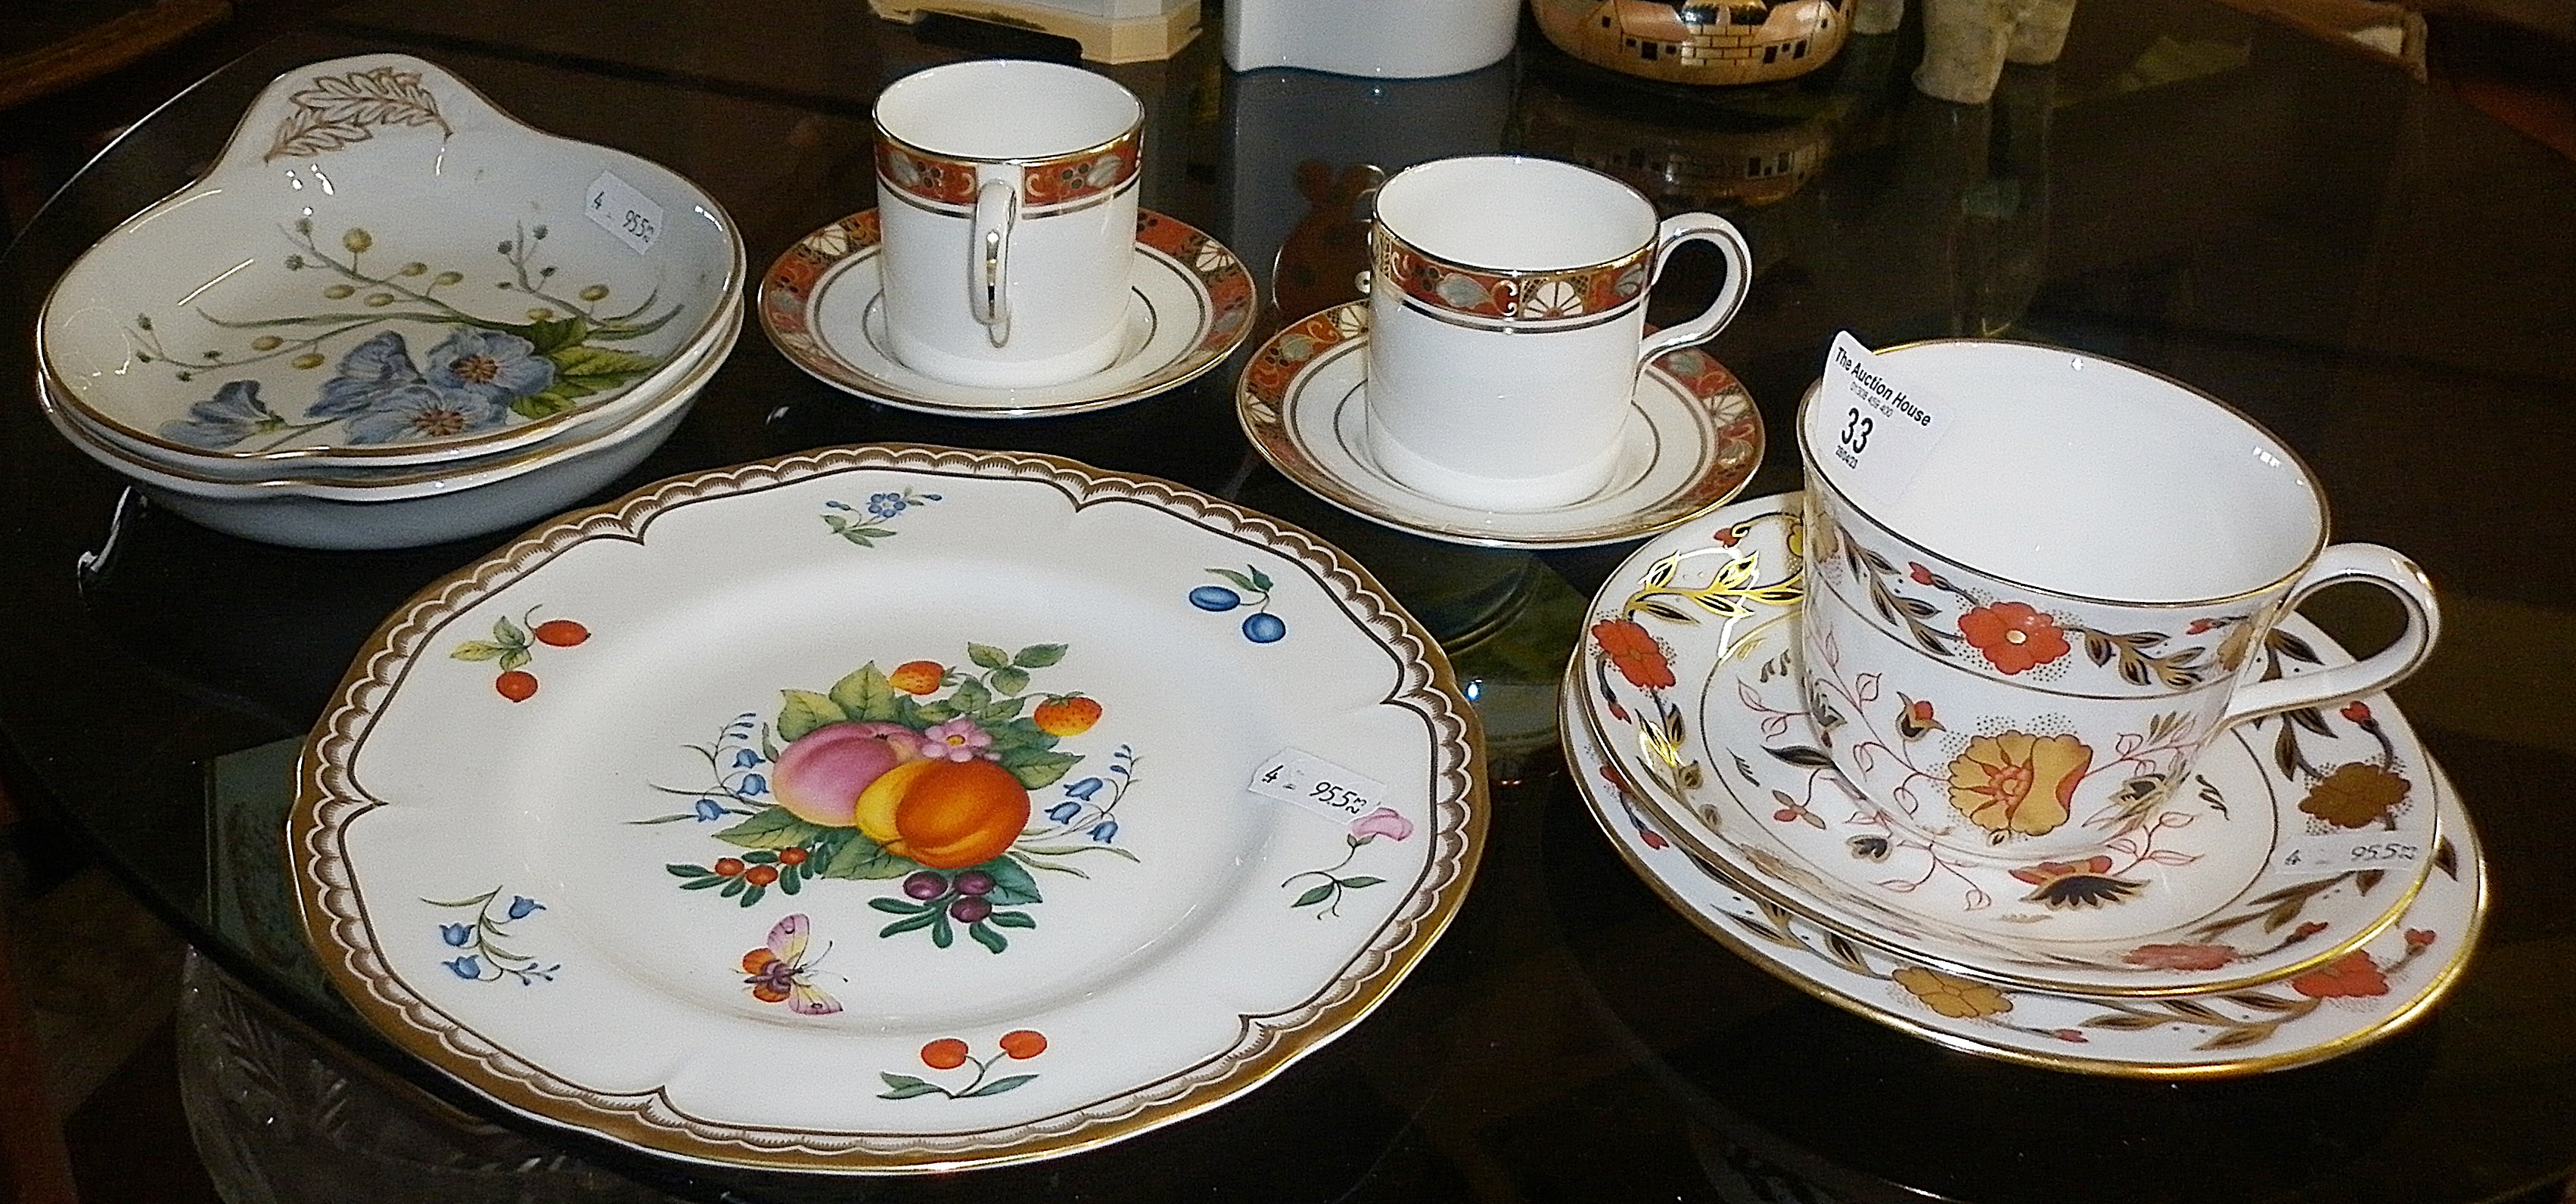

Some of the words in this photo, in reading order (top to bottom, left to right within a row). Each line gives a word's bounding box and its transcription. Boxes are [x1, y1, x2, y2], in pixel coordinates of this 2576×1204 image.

[591, 191, 604, 209] 4
[1835, 346, 1852, 371] The
[1851, 362, 1893, 400] Auction
[1891, 392, 1931, 426] House
[1841, 407, 1873, 454] 33
[1261, 765, 1283, 784] 4
